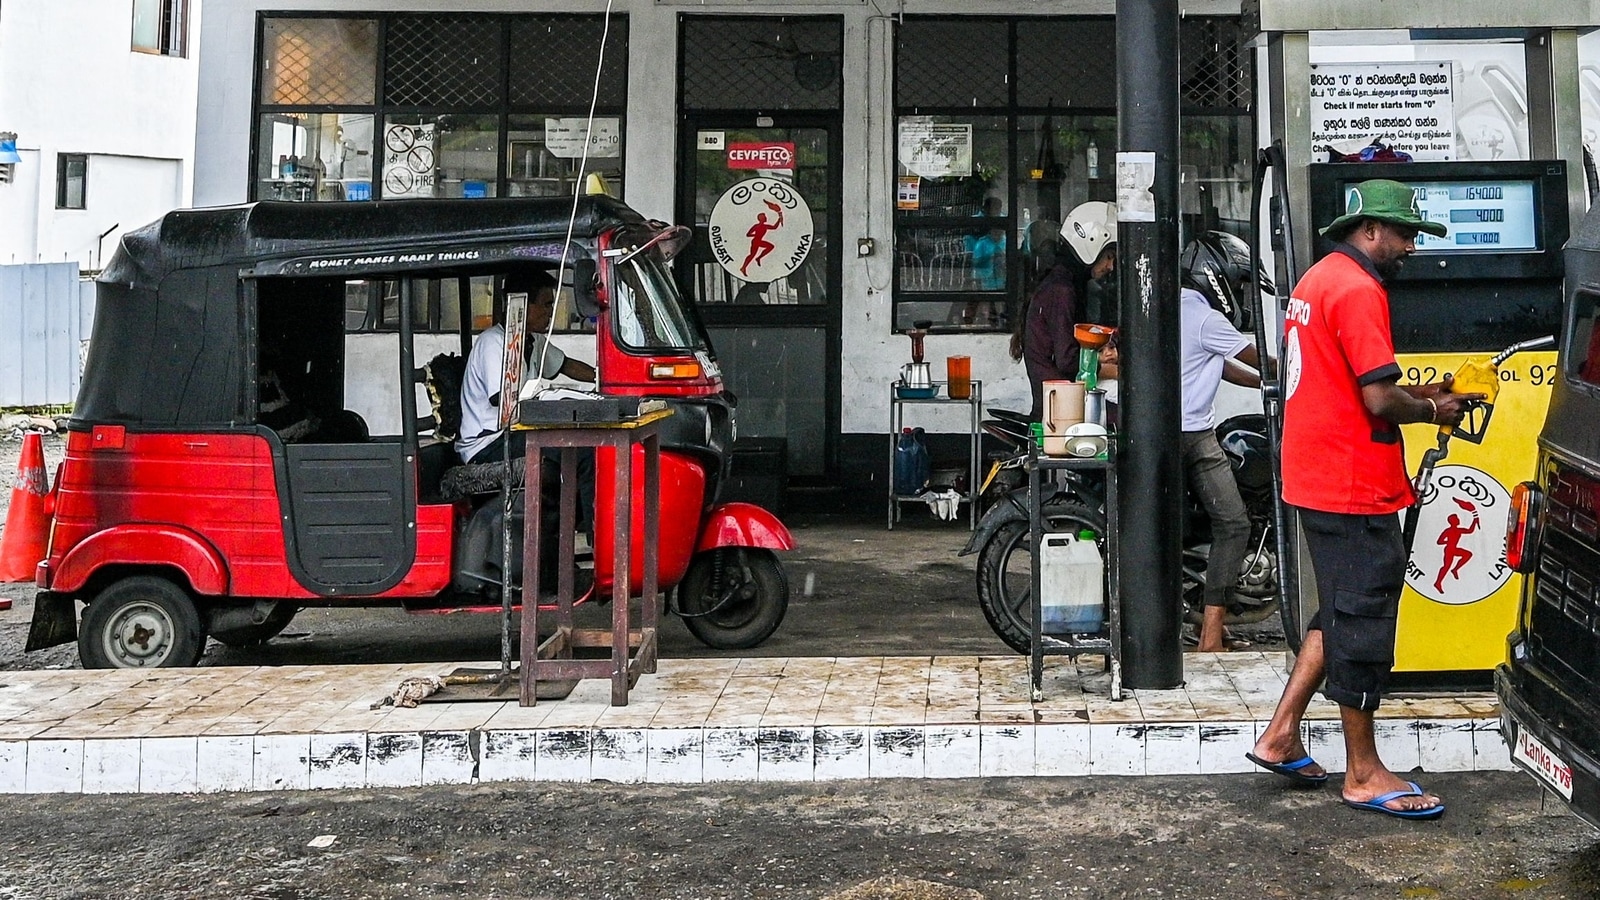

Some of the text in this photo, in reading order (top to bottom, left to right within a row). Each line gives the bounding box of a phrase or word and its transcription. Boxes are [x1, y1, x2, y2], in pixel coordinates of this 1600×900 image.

[1323, 101, 1347, 110] Check
[1349, 101, 1354, 110] if
[1356, 101, 1378, 109] meter
[1380, 101, 1402, 109] starts
[1404, 100, 1422, 109] from
[591, 135, 598, 144] 6
[608, 135, 619, 144] 10
[1389, 143, 1413, 151] efore
[1415, 144, 1429, 152] you
[1430, 142, 1451, 151] leave
[729, 149, 790, 161] CEYPETCO
[415, 174, 435, 187] FIRE
[731, 181, 798, 210] ලංකා
[309, 258, 352, 269] MONEY
[398, 253, 435, 263] MANY
[438, 250, 480, 260] THINGS
[784, 233, 811, 271] LANKA
[1203, 266, 1232, 313] JOPPA
[1407, 366, 1437, 386] 92
[1524, 733, 1551, 772] Lanka
[1553, 764, 1572, 789] TVS
